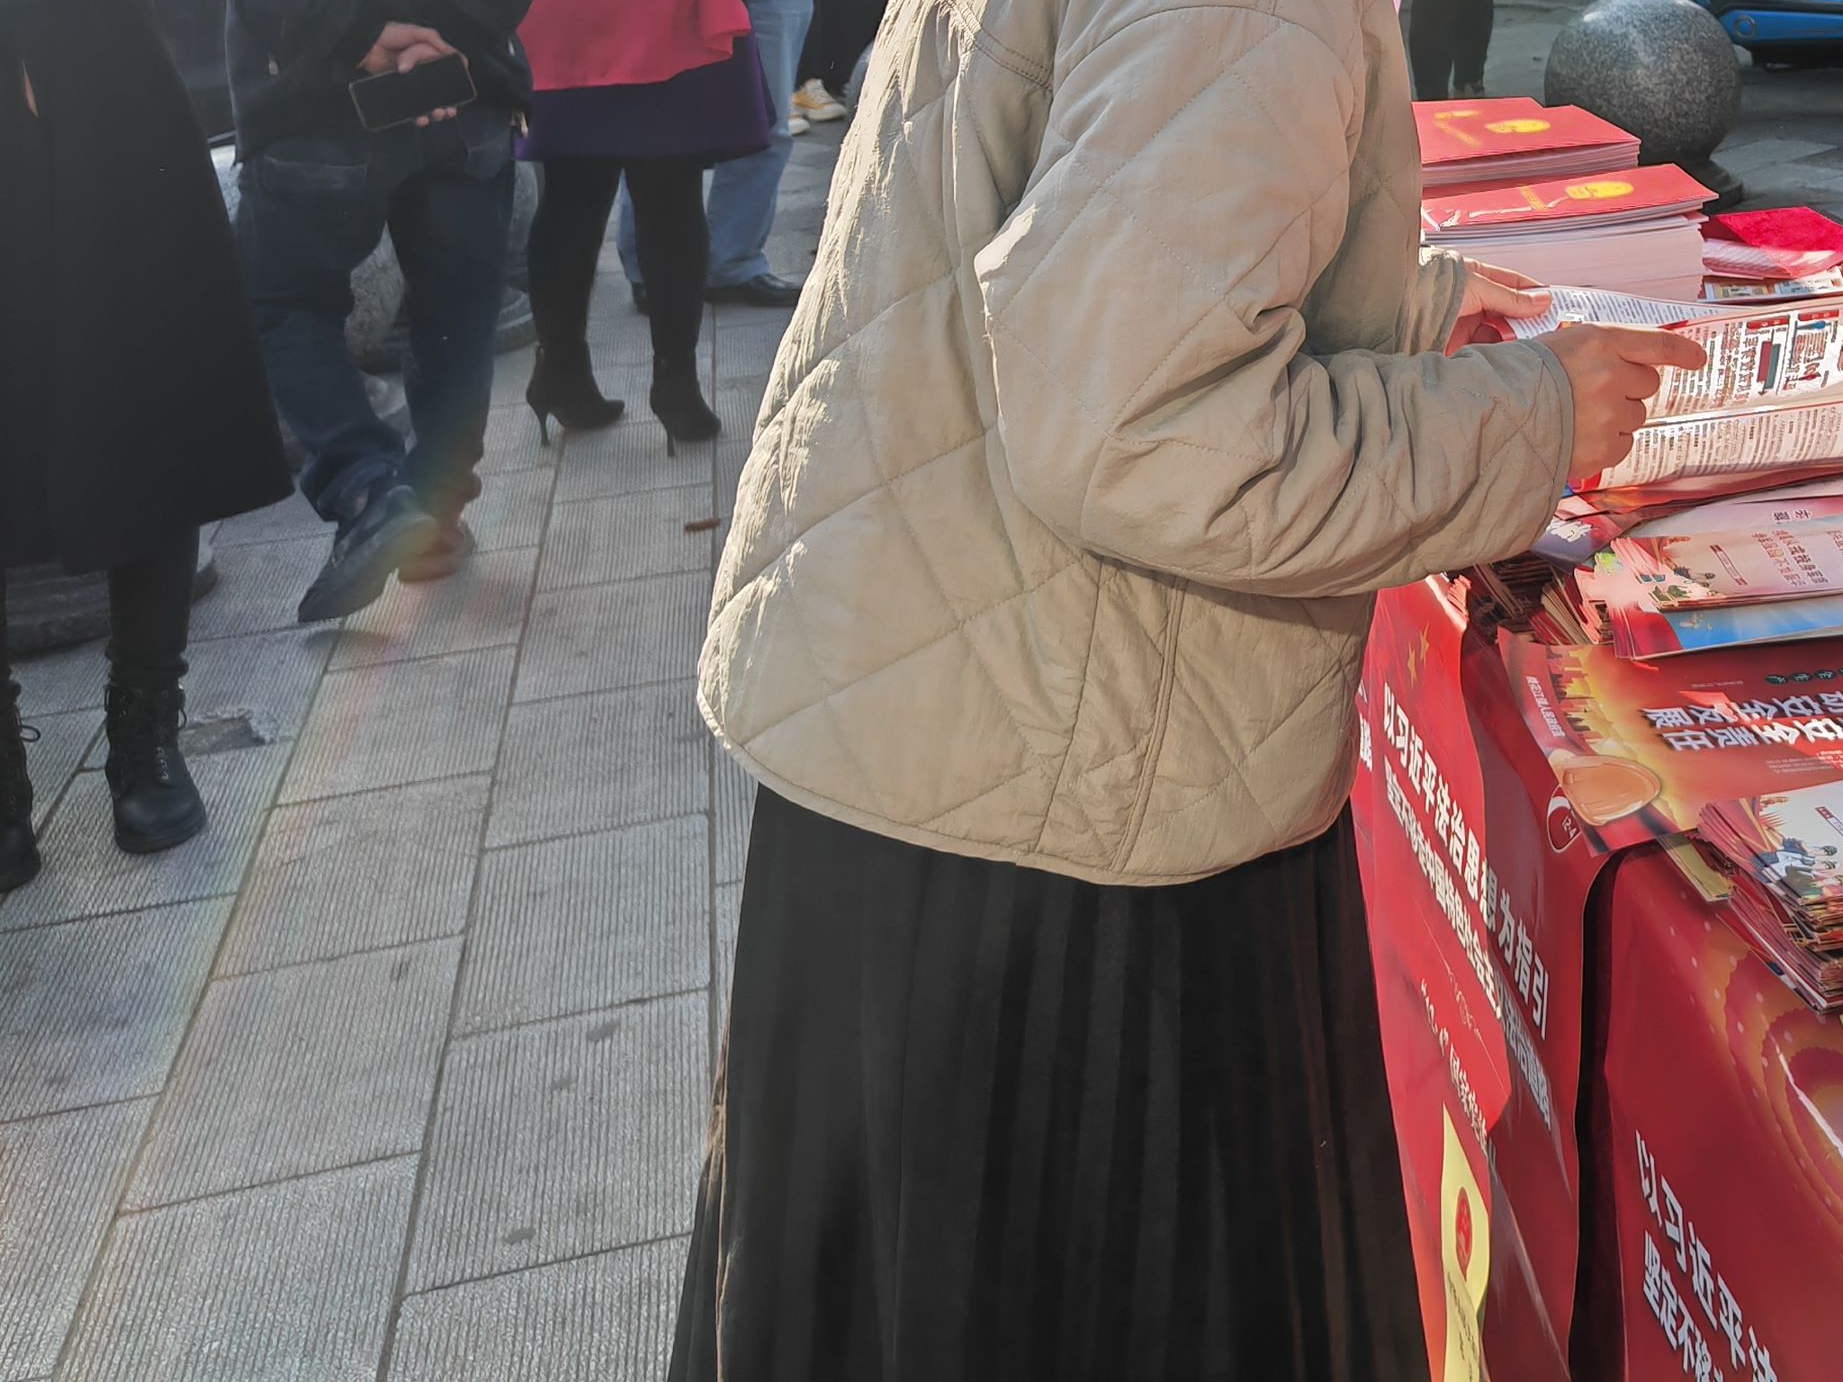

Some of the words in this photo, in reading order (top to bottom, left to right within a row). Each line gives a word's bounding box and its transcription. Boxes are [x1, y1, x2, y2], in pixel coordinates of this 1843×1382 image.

[1384, 681, 1549, 1041] 以习近平法治思想为指引
